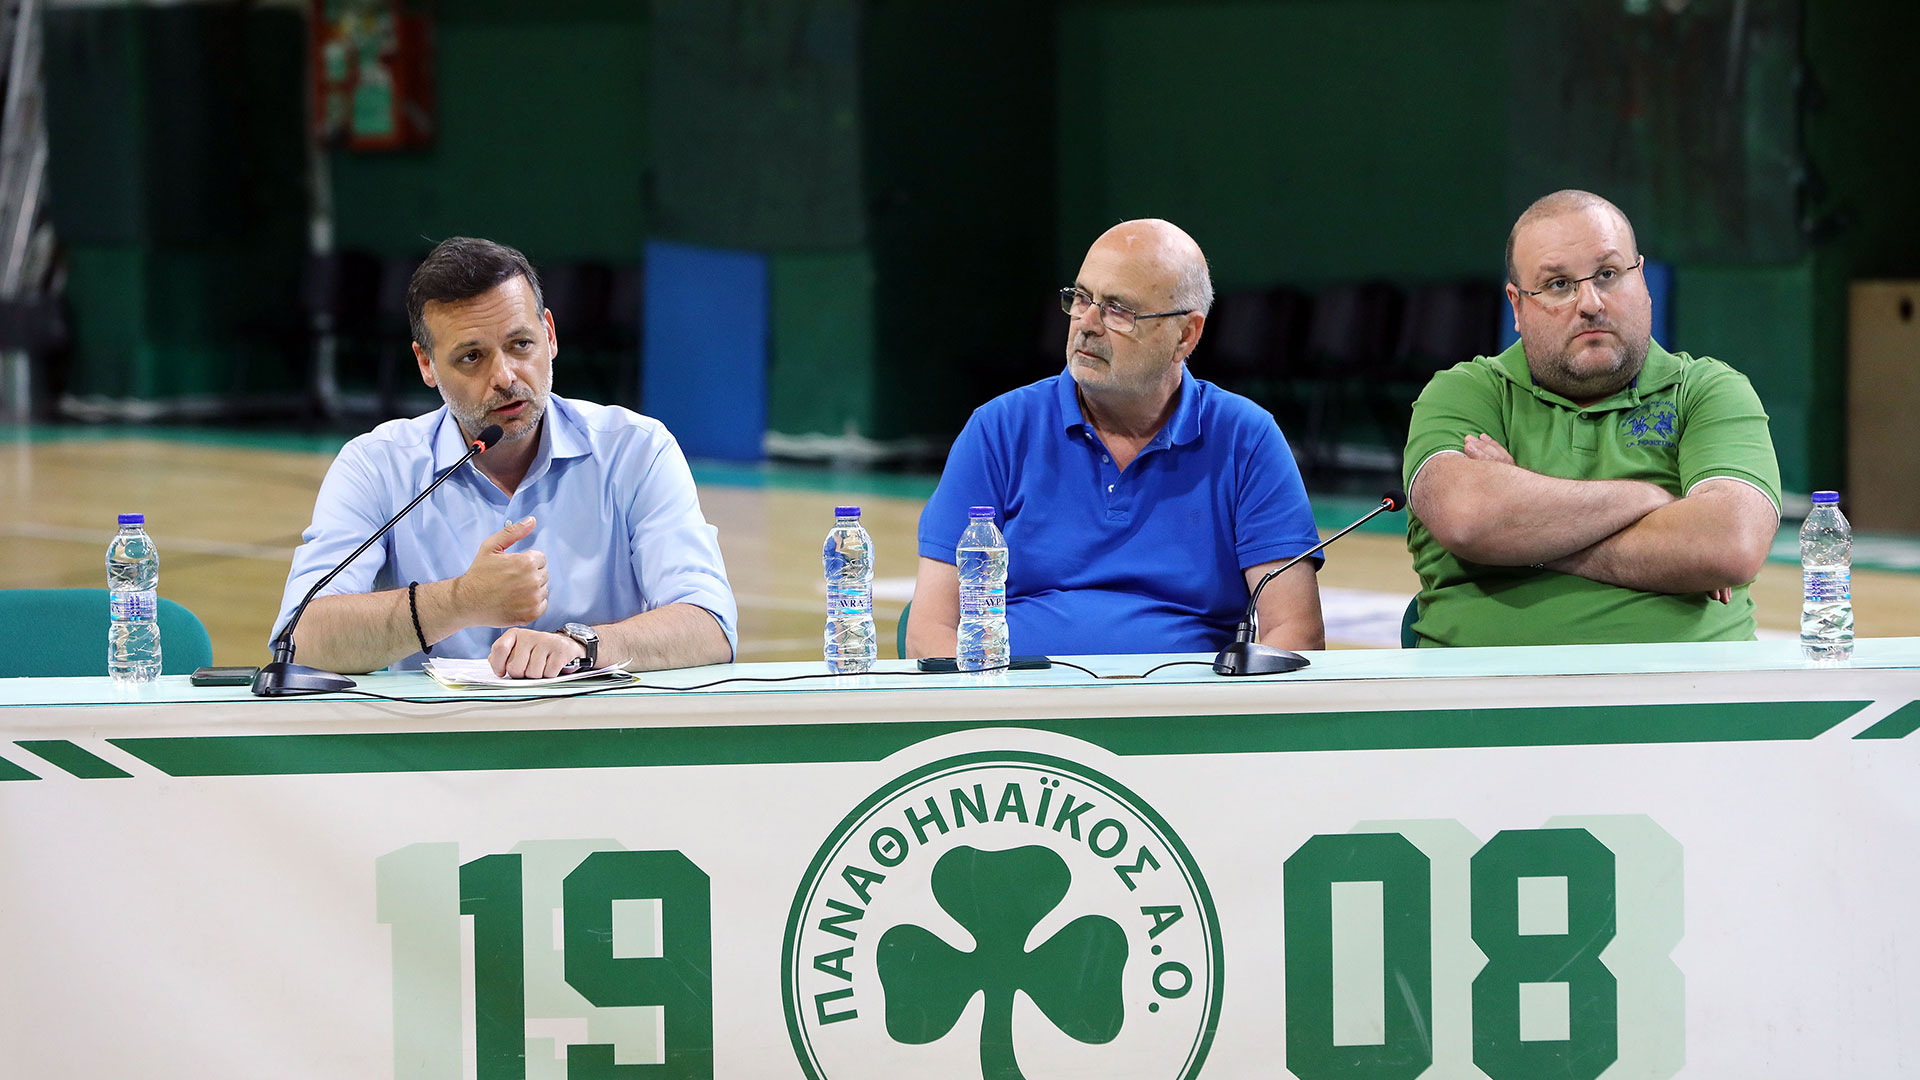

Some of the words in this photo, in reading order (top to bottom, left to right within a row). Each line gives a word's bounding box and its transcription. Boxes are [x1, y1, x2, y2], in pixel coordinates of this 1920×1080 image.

[458, 849, 714, 1080] 19
[812, 775, 1162, 1027] ΠΑΝΑΘΗΝΑΪΚΟΣ
[1282, 827, 1619, 1080] 08
